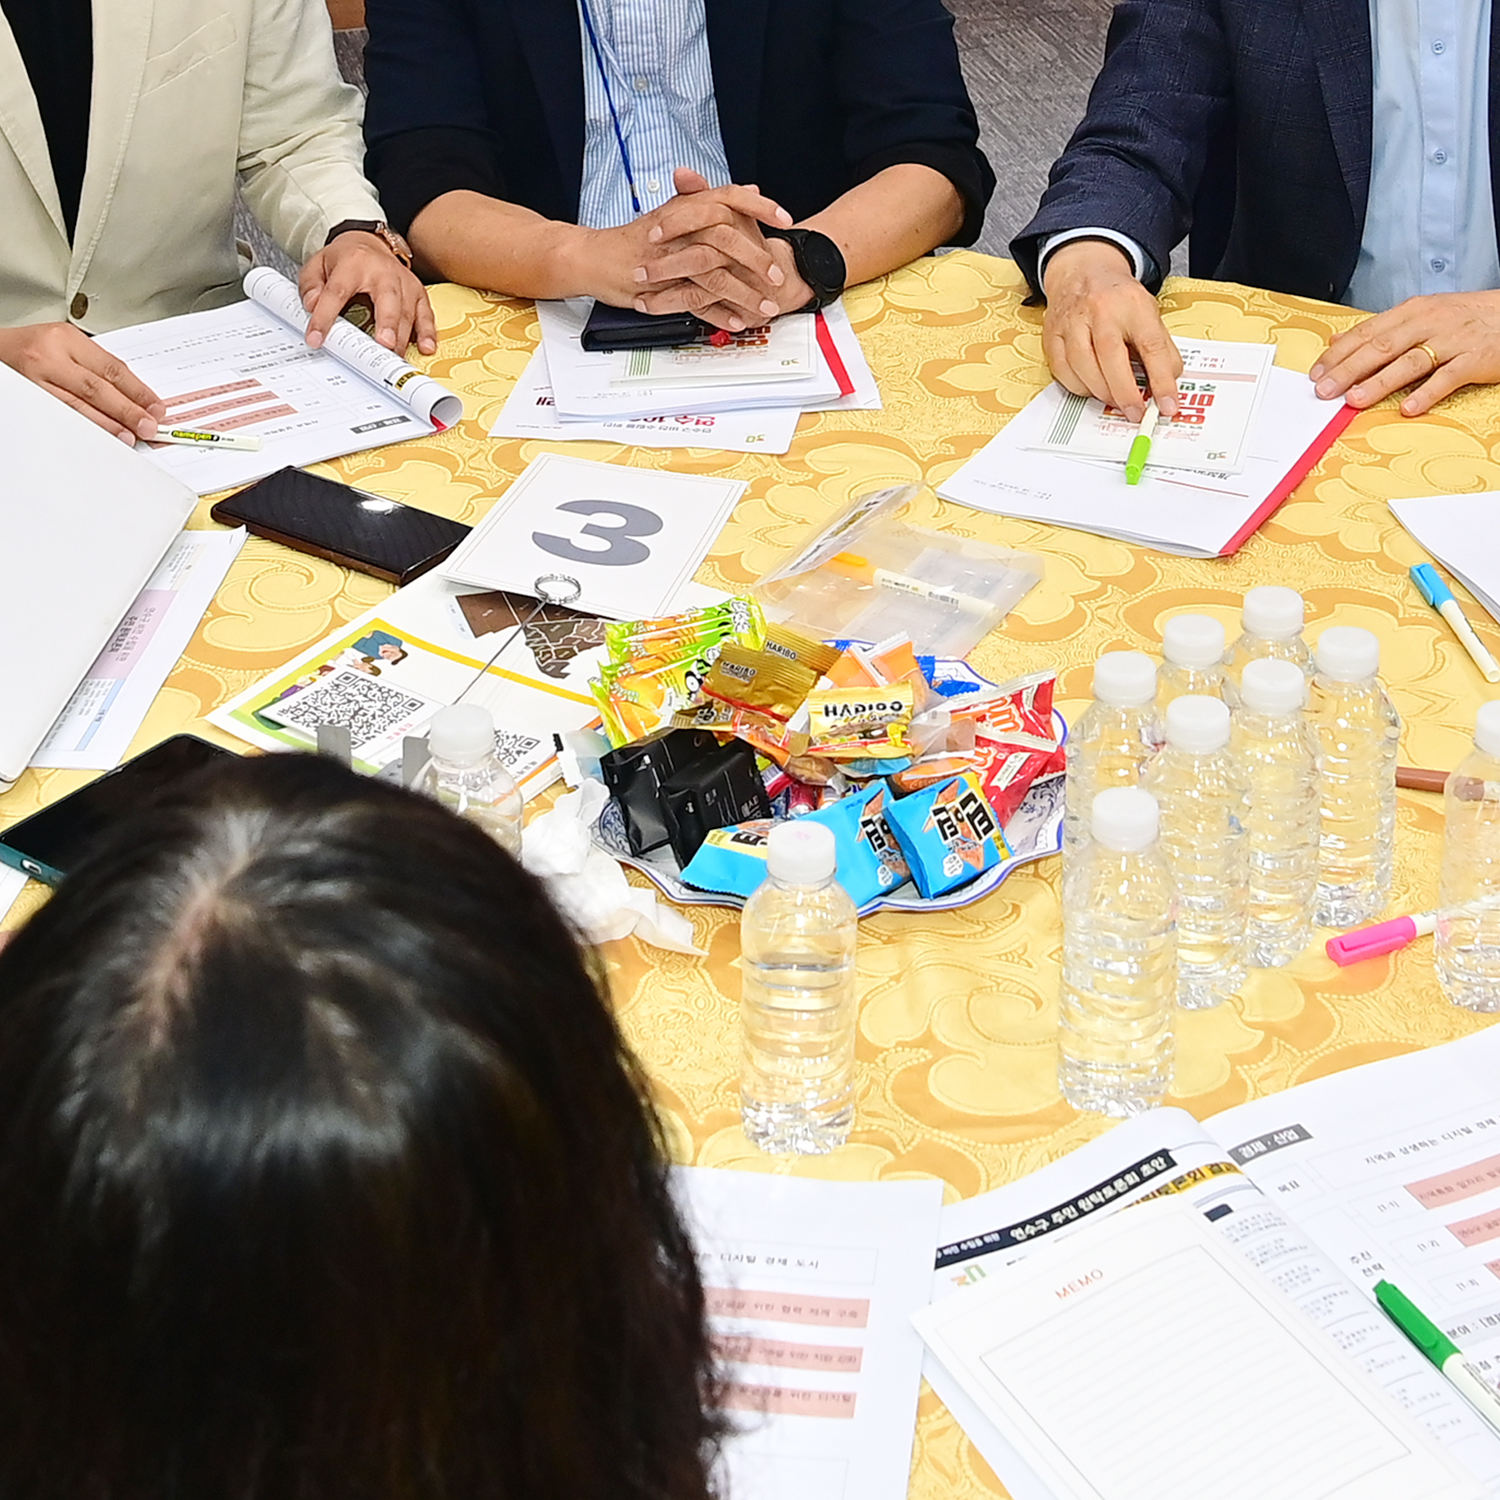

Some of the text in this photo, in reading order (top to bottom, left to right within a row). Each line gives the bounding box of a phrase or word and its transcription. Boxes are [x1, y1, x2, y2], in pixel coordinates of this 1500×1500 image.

[532, 499, 664, 566] 3
[765, 639, 797, 661] HARIBO
[1236, 1138, 1266, 1159] 경제
[1009, 1216, 1052, 1244] 연수구
[1055, 1269, 1103, 1300] MEMO
